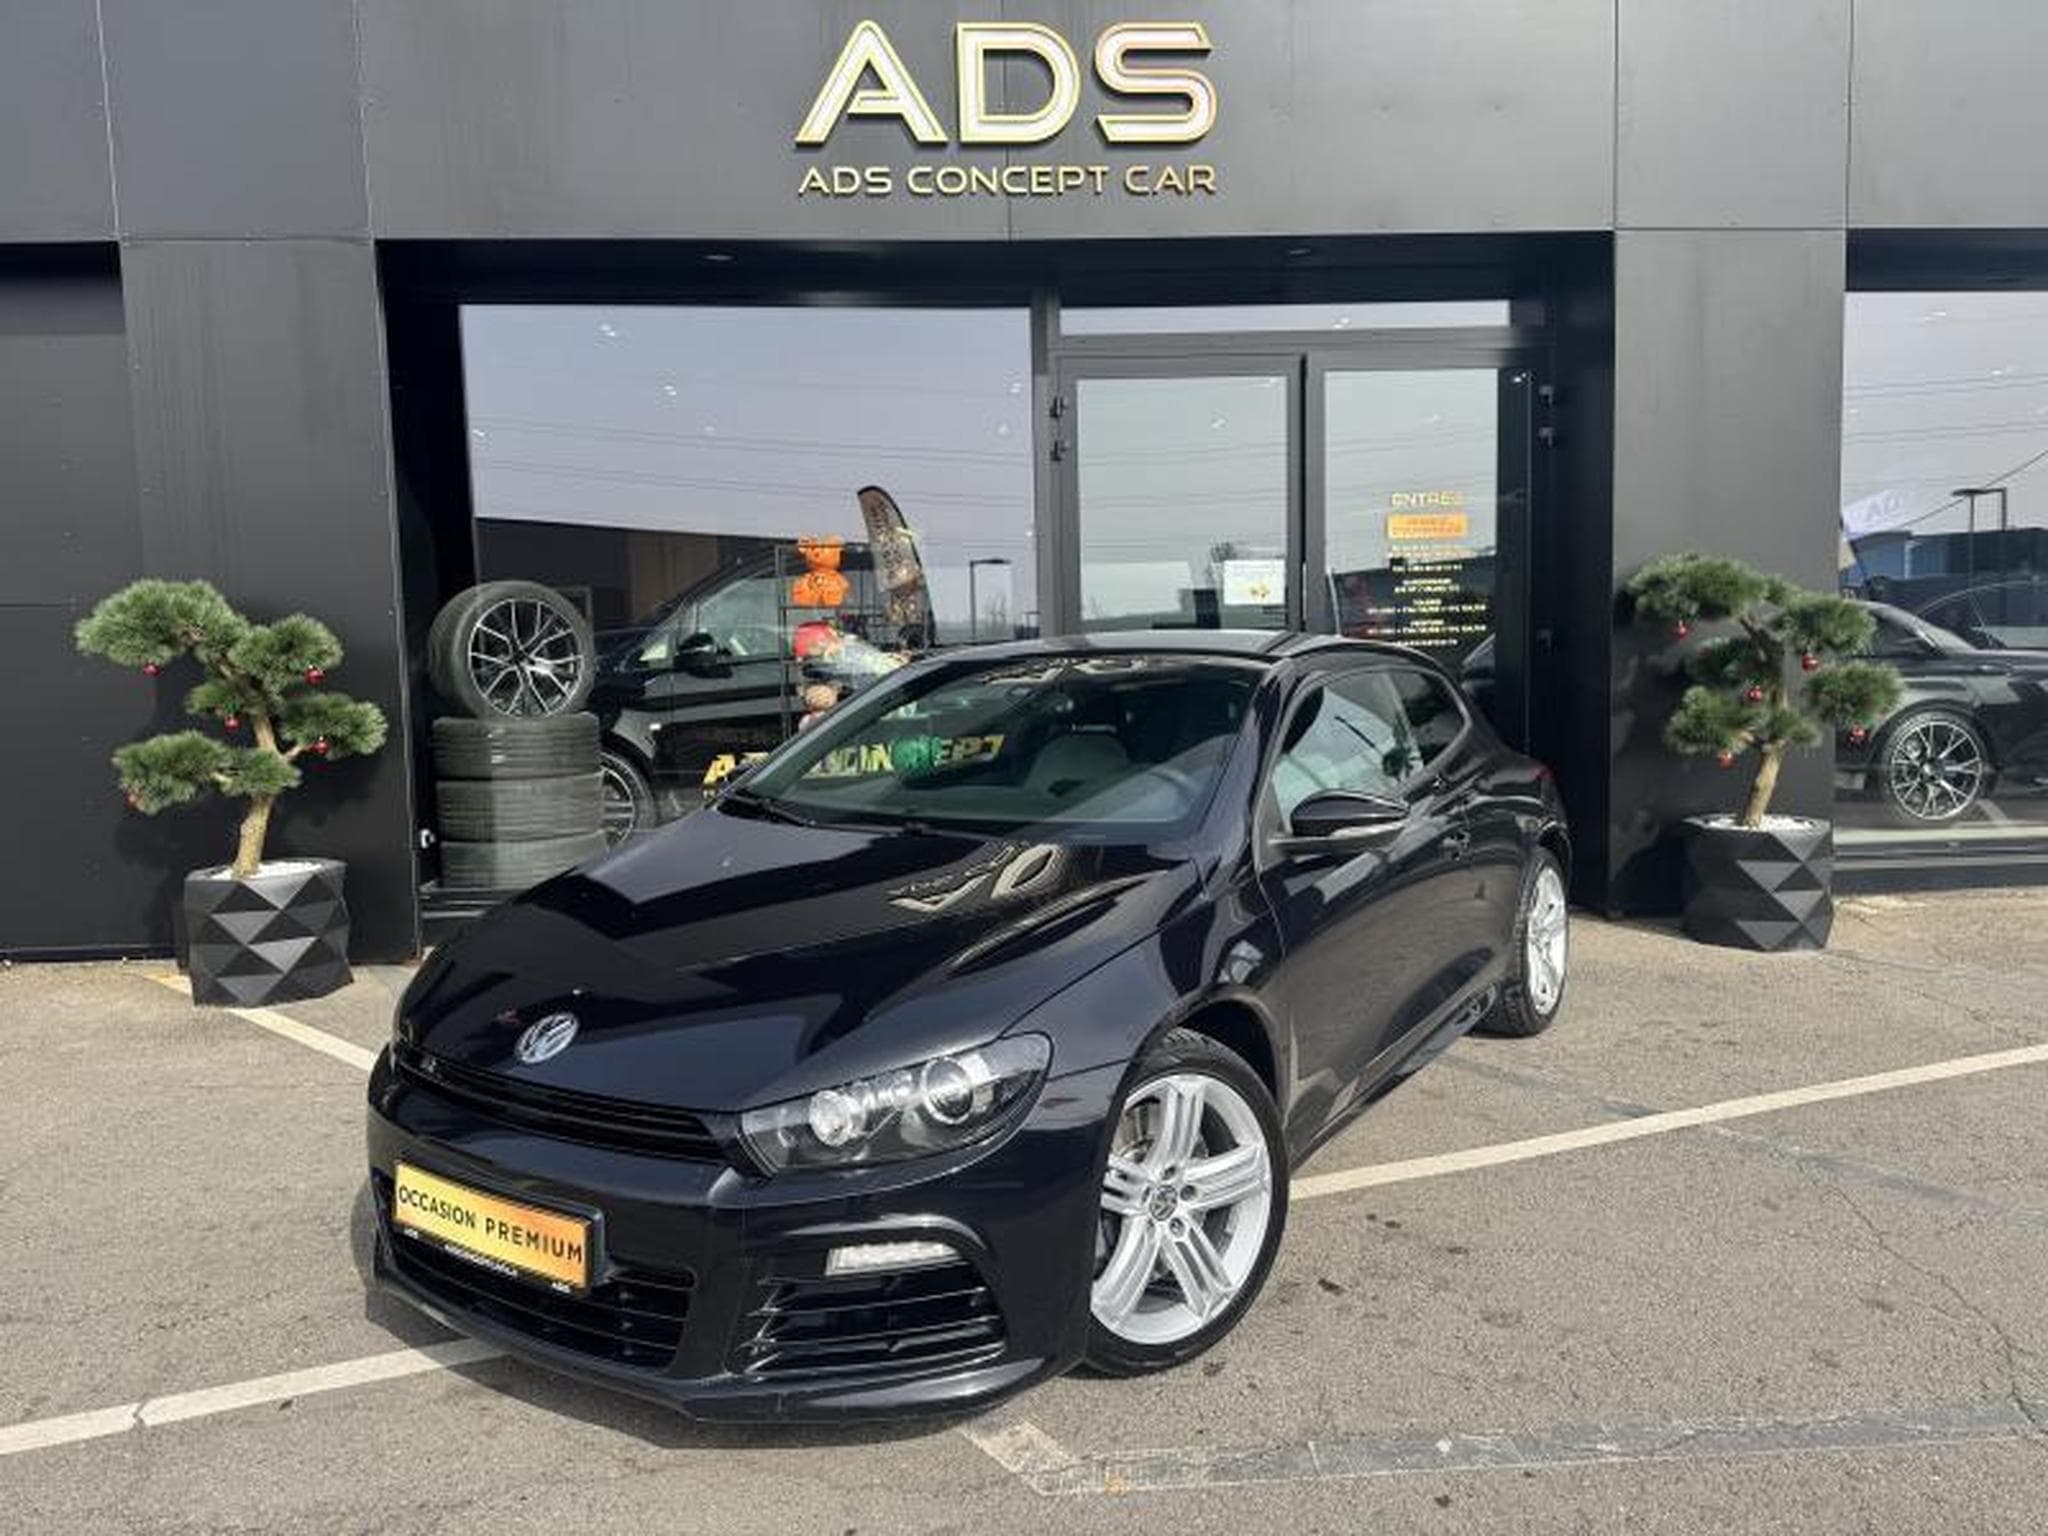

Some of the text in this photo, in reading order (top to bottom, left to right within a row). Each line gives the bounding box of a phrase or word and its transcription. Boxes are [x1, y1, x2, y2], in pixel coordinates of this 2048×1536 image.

[795, 20, 1217, 144] ADS
[799, 165, 1217, 194] ADS CONCEPT CAR
[398, 1185, 476, 1228] OCCASION
[485, 1217, 582, 1262] PREMIUM
